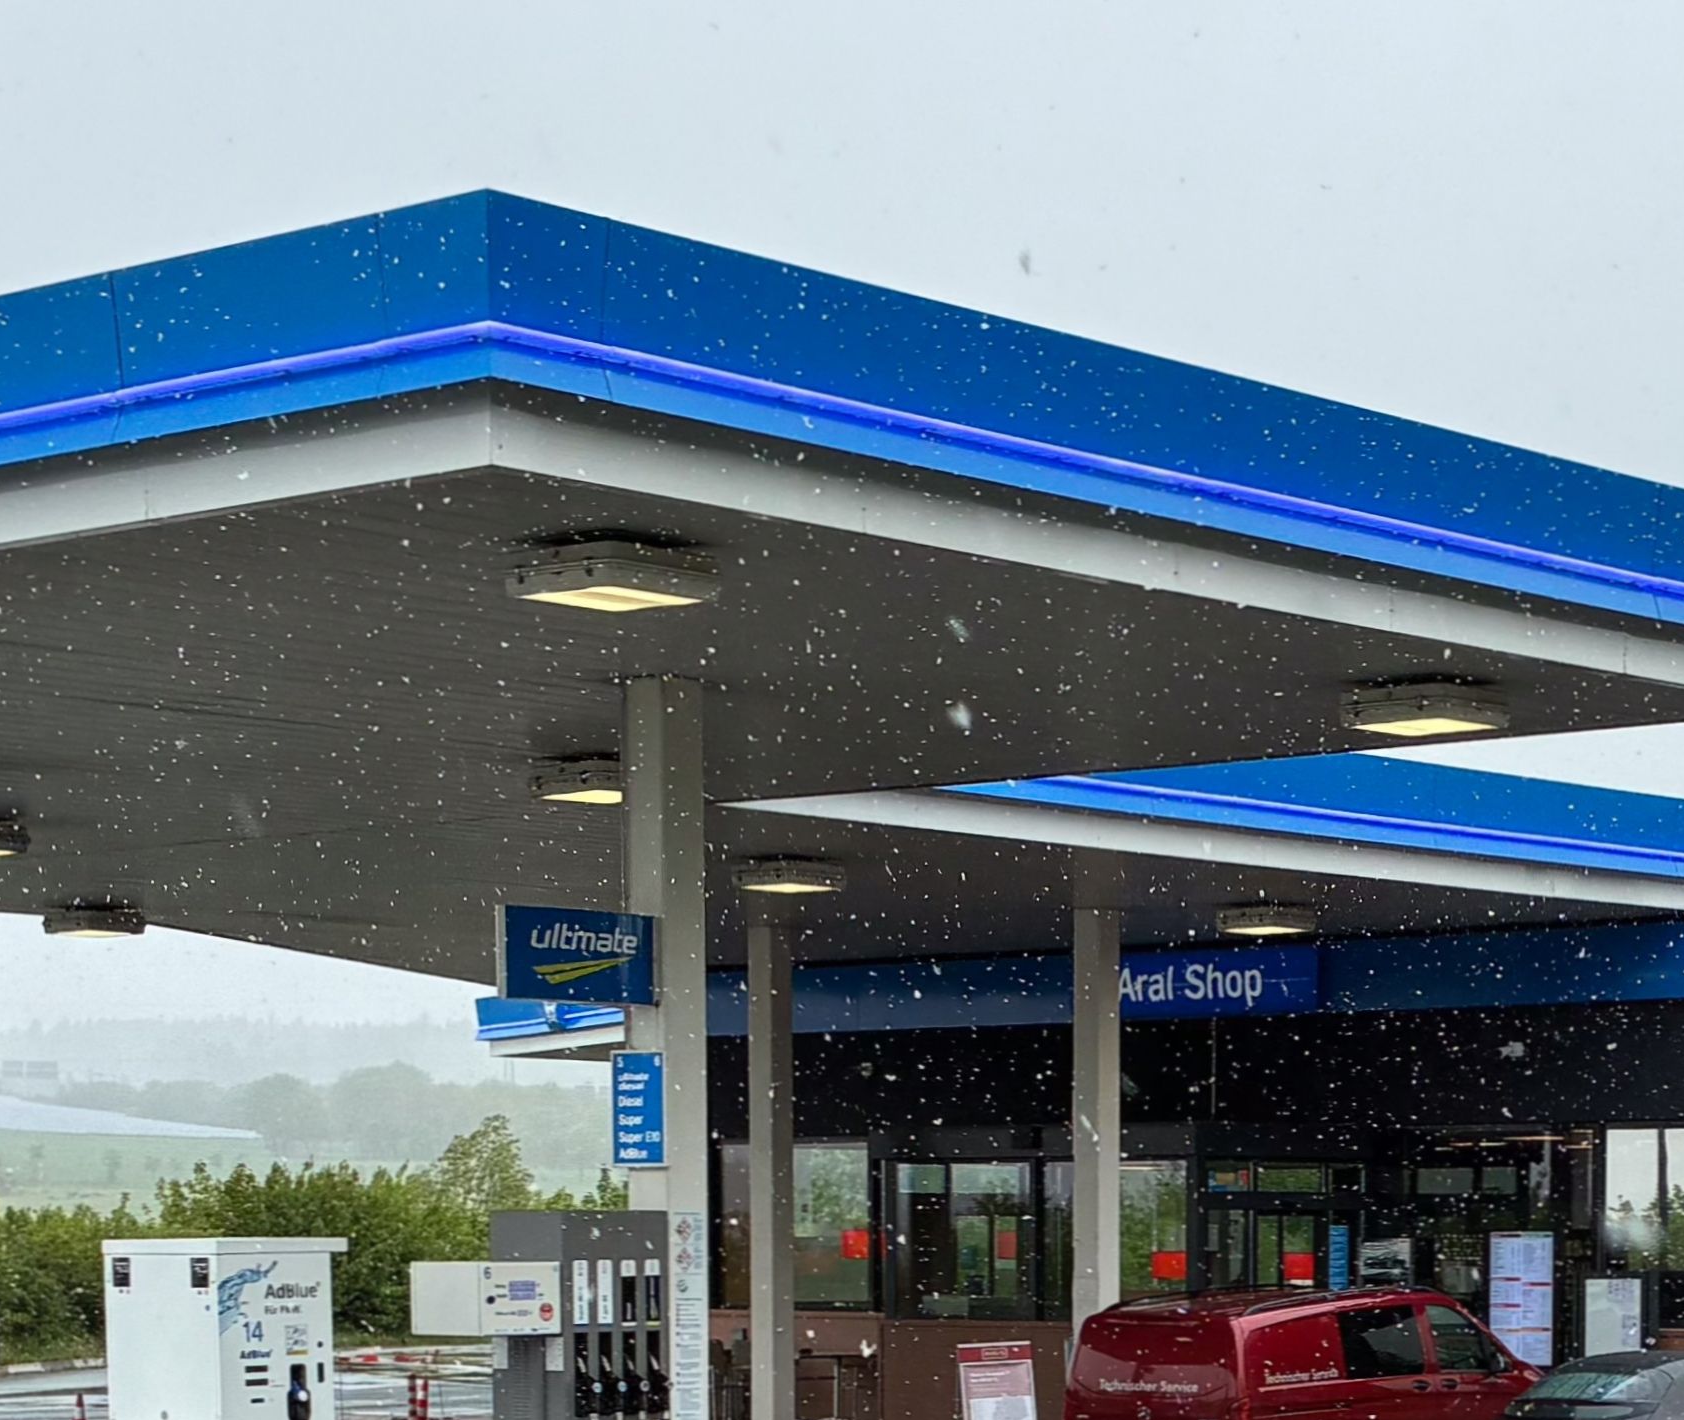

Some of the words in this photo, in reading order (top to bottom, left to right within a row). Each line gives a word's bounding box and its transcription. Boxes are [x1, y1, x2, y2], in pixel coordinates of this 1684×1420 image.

[530, 923, 638, 955] ultimate
[1119, 965, 1174, 1002] Aral
[1184, 963, 1263, 1008] Shop
[618, 1114, 644, 1126] Super
[619, 1131, 644, 1144] Super
[242, 1320, 264, 1343] 14
[1099, 1378, 1157, 1393] Technischer
[1160, 1380, 1199, 1394] Service
